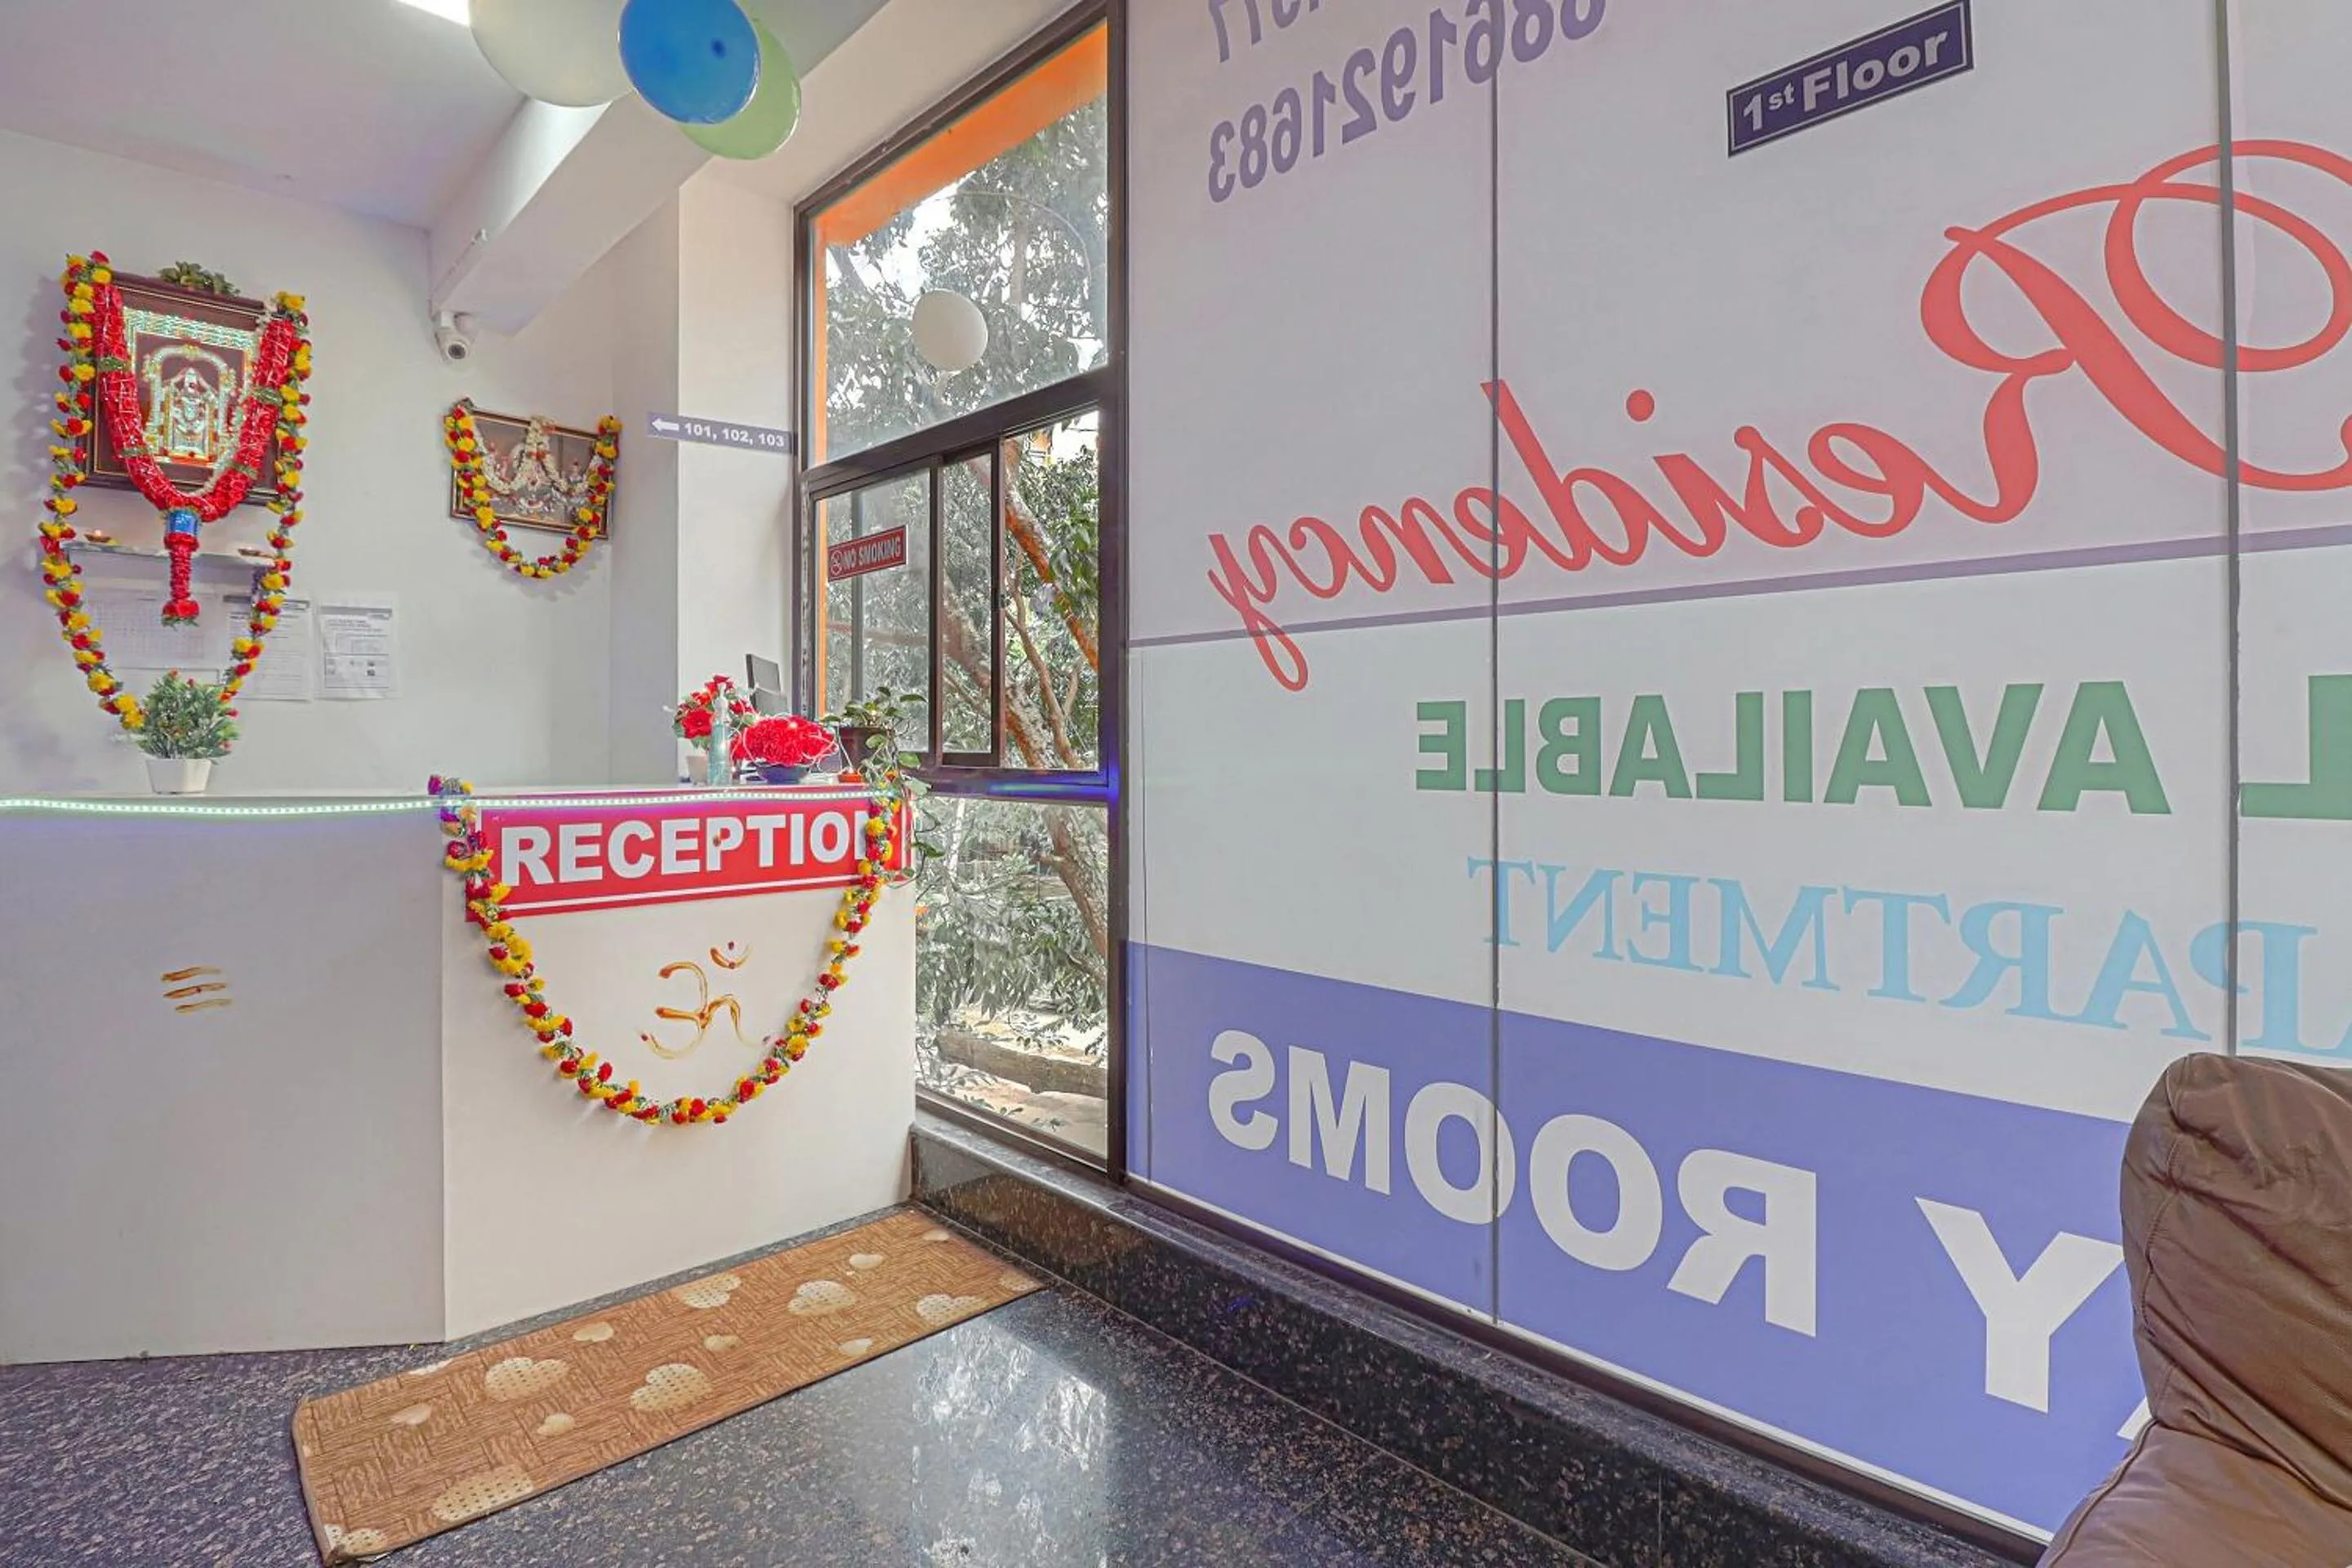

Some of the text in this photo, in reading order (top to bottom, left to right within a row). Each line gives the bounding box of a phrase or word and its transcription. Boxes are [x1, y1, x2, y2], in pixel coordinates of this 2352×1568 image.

[1742, 31, 1949, 131] 1st Floor
[684, 422, 785, 447] 101, 102, 103
[844, 536, 901, 570] NO SMOKING
[500, 809, 869, 888] RECEPTIO
